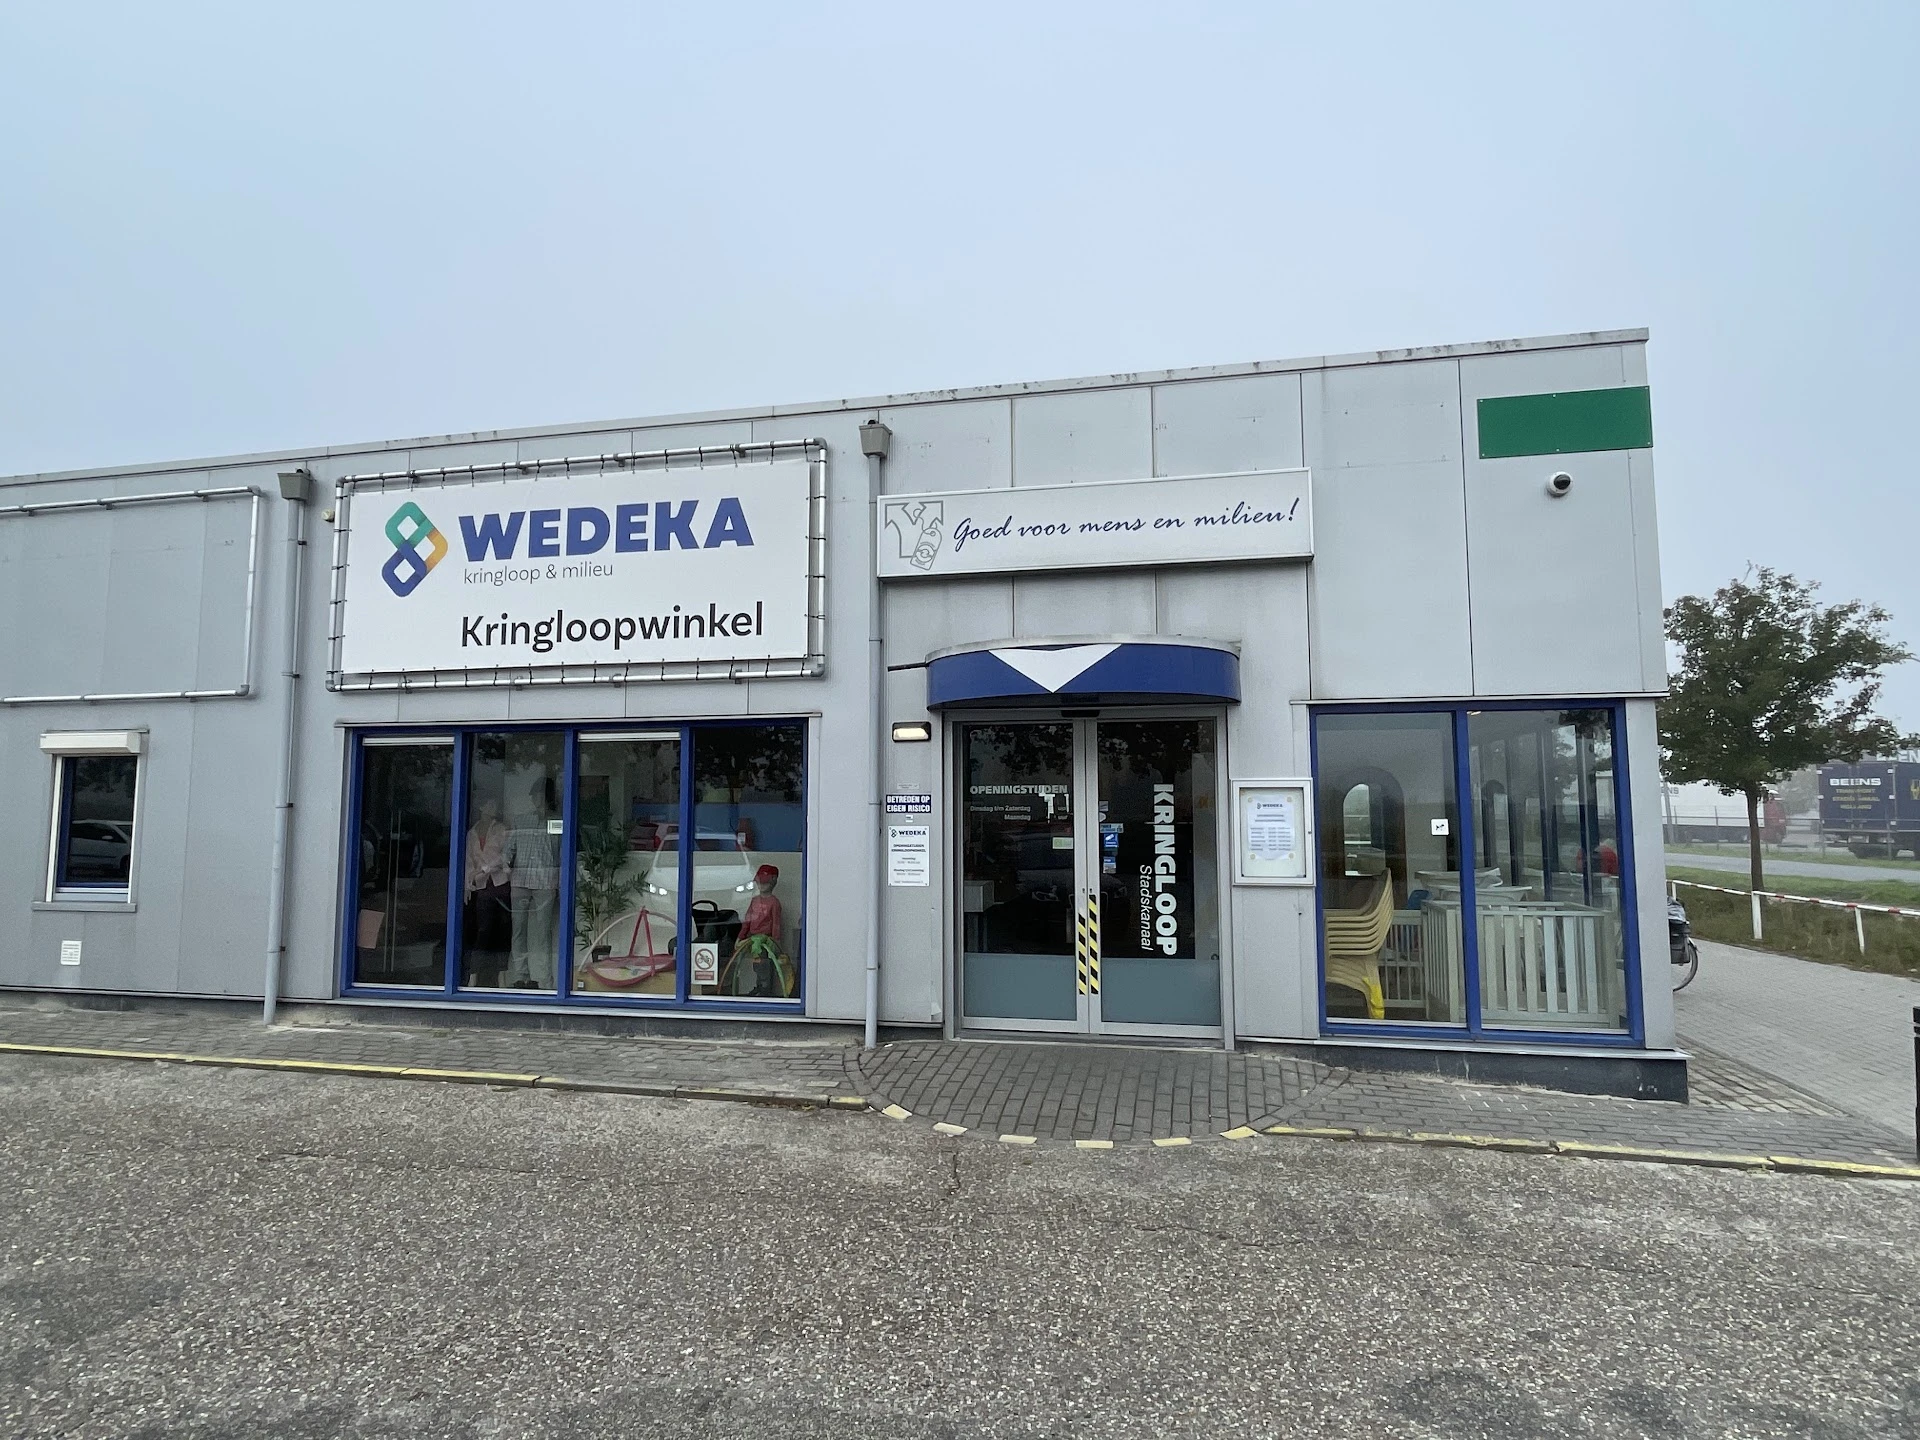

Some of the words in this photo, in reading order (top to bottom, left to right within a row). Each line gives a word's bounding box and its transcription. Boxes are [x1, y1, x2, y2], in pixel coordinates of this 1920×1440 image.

[458, 497, 755, 562] WEDEKA
[953, 515, 1013, 552] Goed
[1018, 522, 1071, 537] voor
[1079, 519, 1146, 533] mens
[1153, 517, 1185, 529] en
[1194, 497, 1300, 527] milieu!
[463, 564, 541, 587] kringloop
[545, 564, 557, 579] &
[562, 561, 613, 579] milieu
[461, 601, 763, 653] Kringloopwinkel
[886, 795, 920, 804] BETREDEN
[921, 795, 931, 803] OP
[886, 804, 907, 813] EIGEN
[907, 804, 931, 813] RISICO
[1153, 783, 1178, 956] KRINGLOOP
[1139, 864, 1154, 951] Stadskanaal
